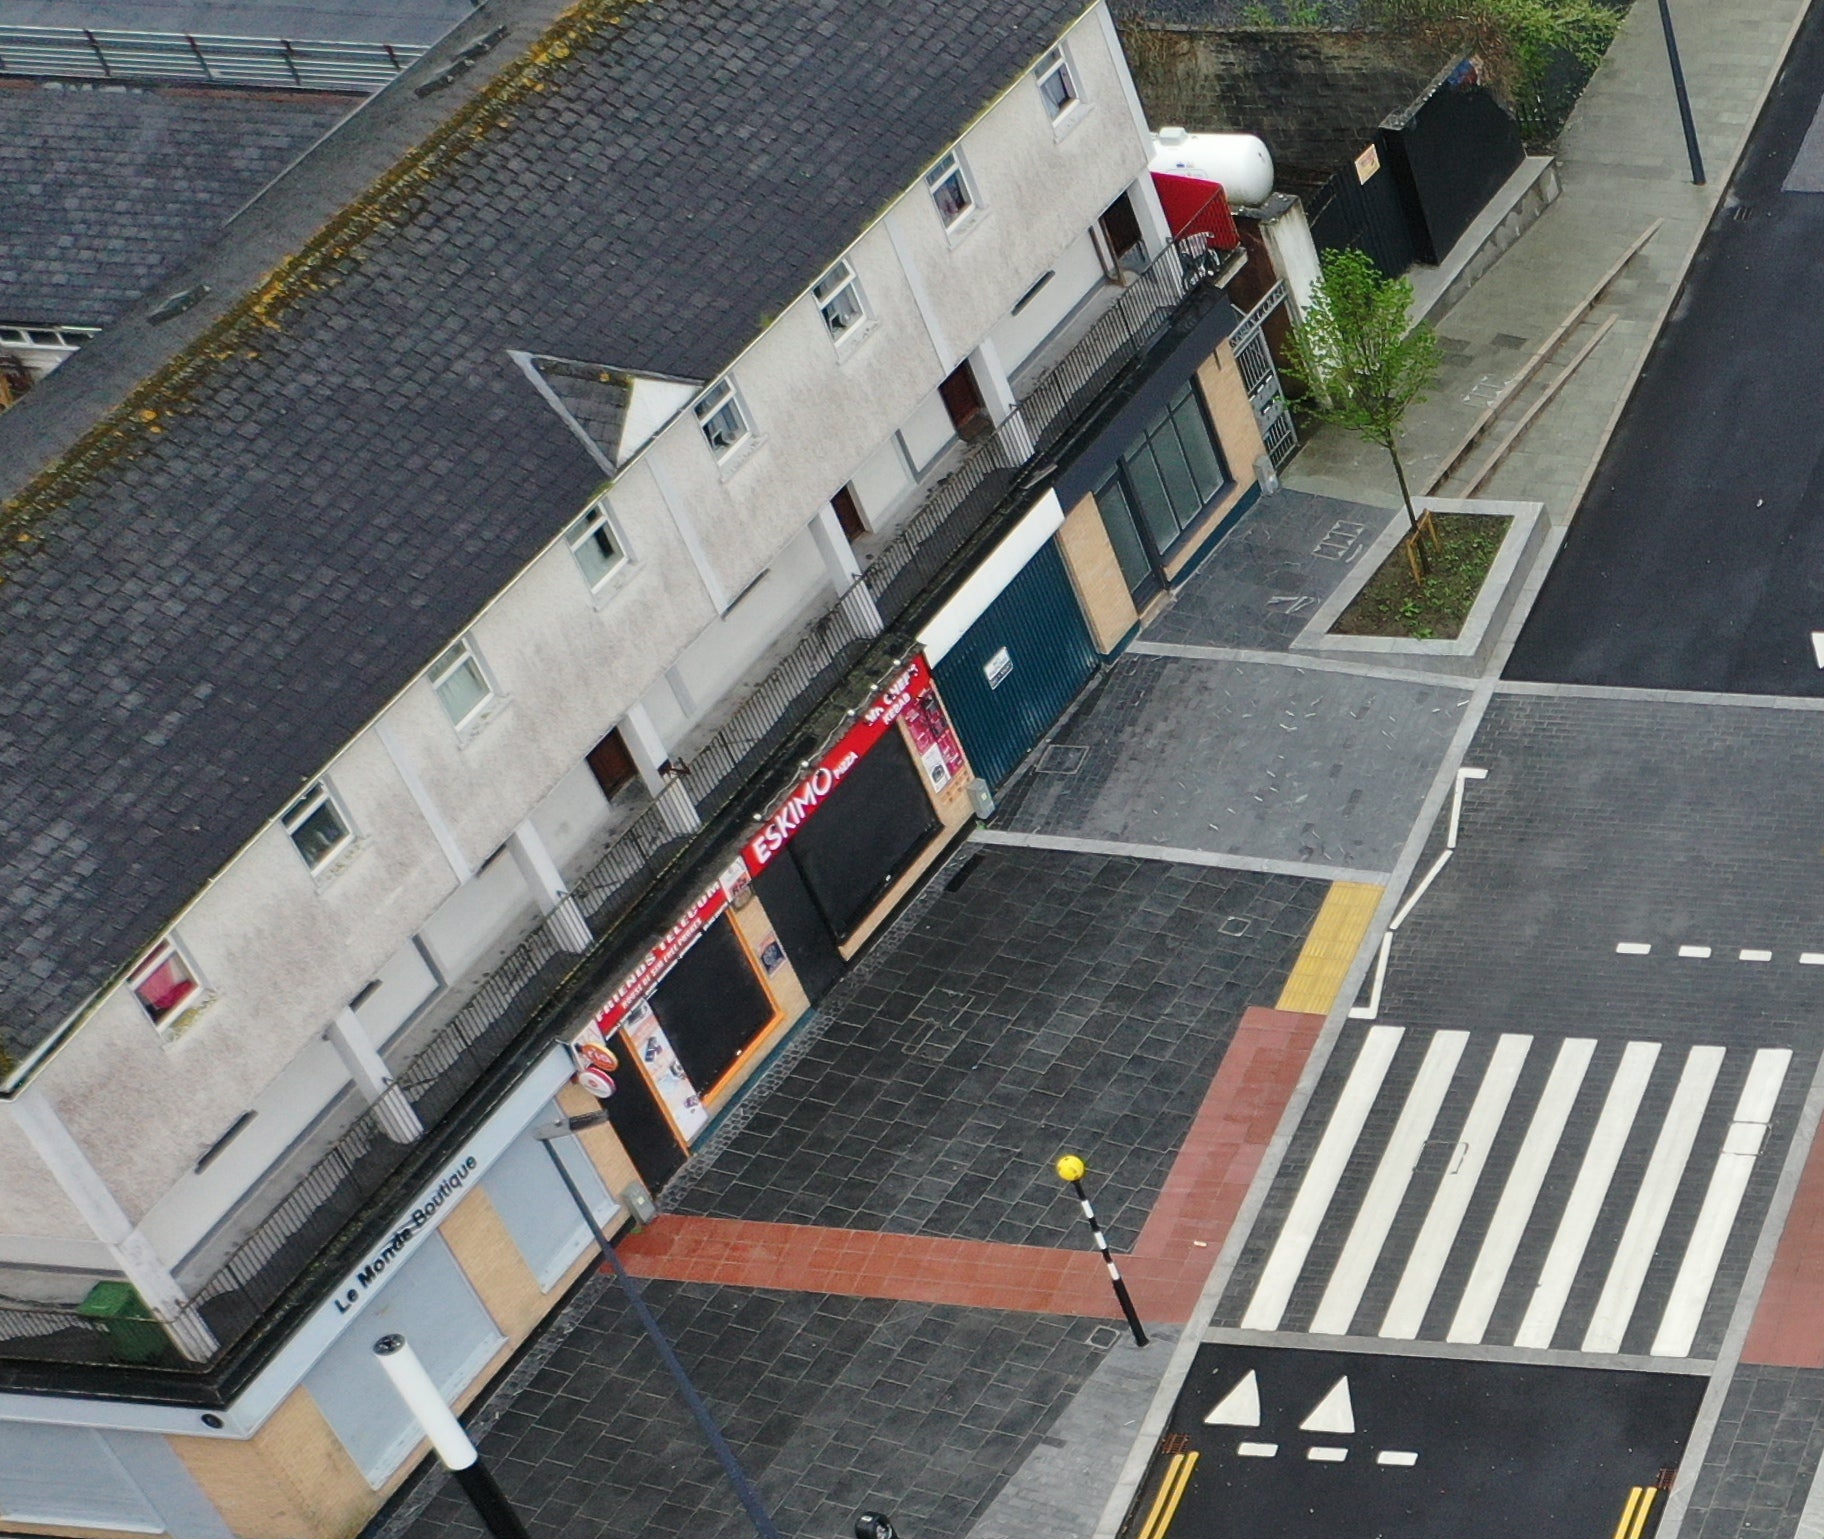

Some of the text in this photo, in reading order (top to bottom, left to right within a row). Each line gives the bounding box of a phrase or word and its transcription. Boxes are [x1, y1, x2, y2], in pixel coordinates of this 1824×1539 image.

[882, 692, 910, 725] KEBAB
[833, 751, 858, 780] PIZZA
[752, 768, 831, 864] ESKIMO
[334, 1156, 477, 1315] Le Monde Boutique
